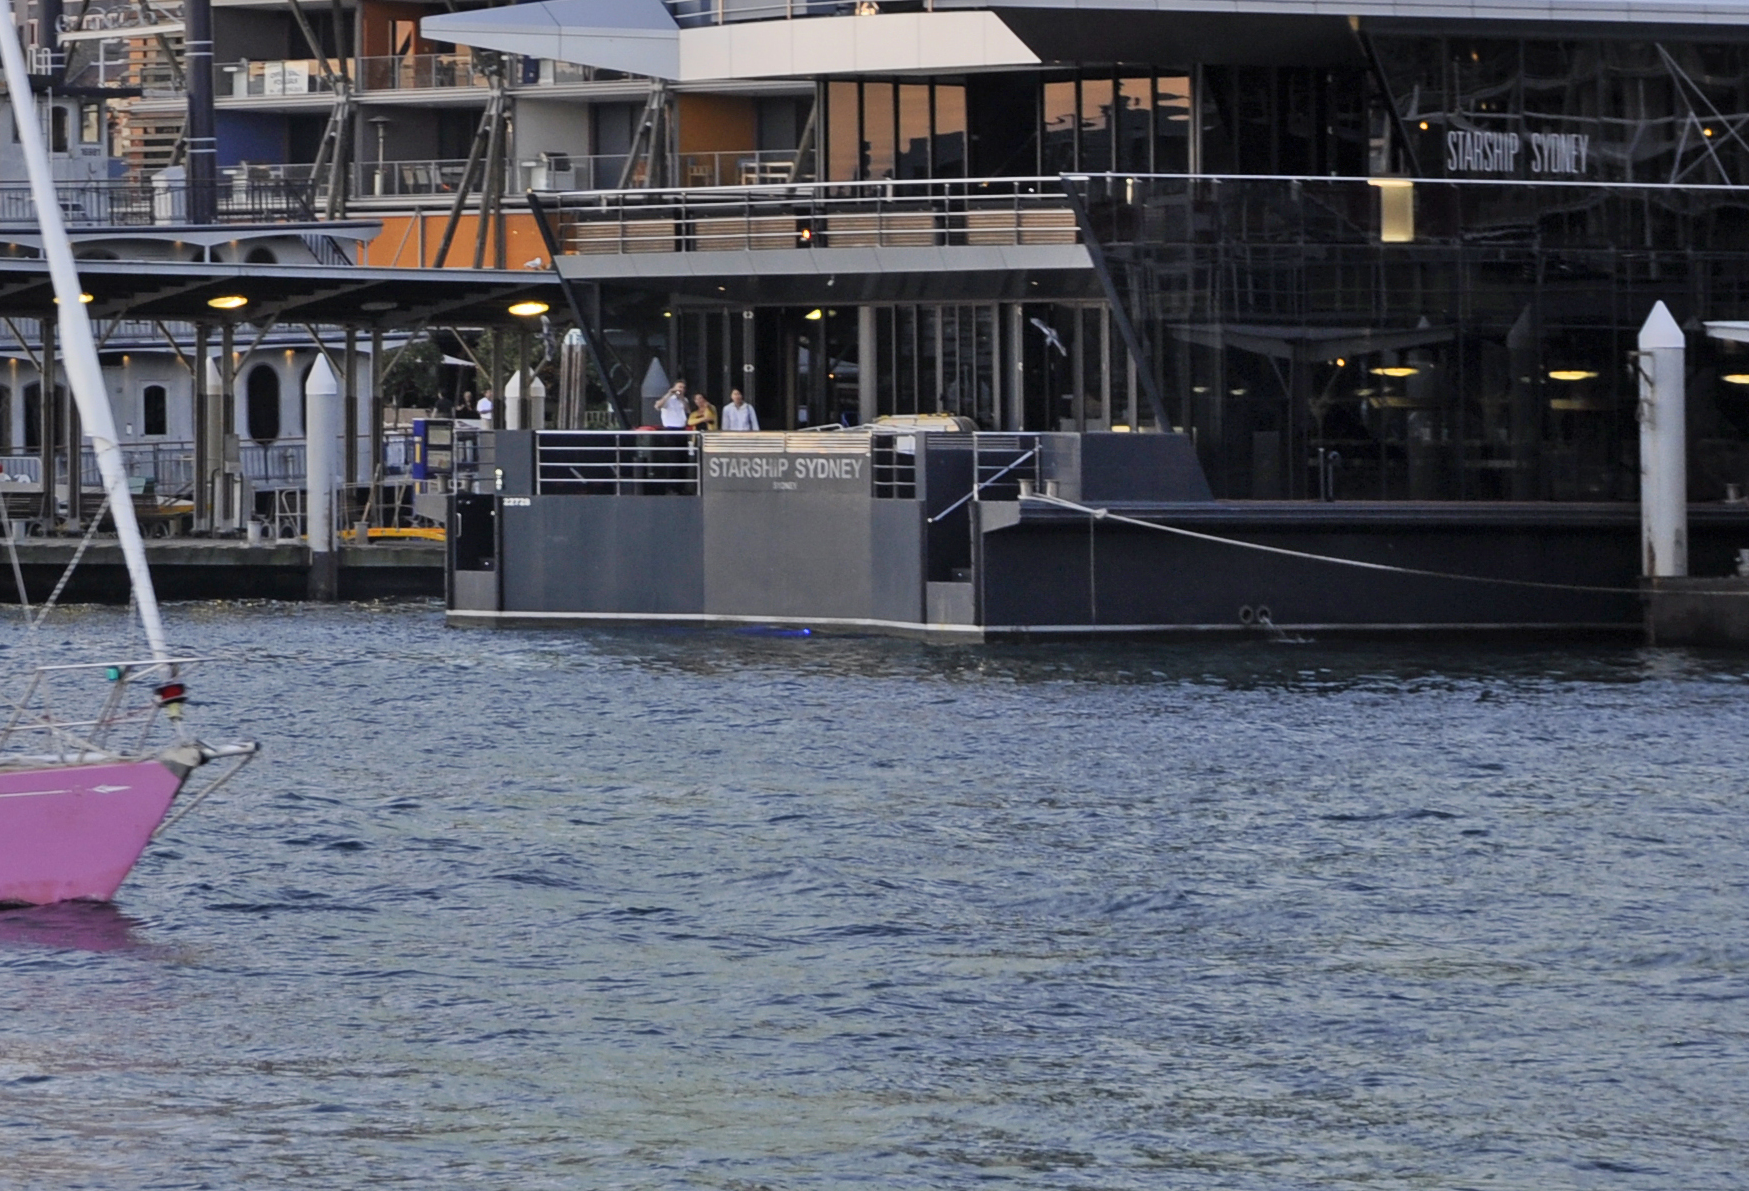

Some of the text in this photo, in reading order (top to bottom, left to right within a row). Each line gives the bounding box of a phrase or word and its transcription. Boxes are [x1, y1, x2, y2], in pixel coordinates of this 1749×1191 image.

[1447, 130, 1589, 174] STARSHIP SYDNEY
[709, 457, 863, 479] STARSHIP SYDNEY
